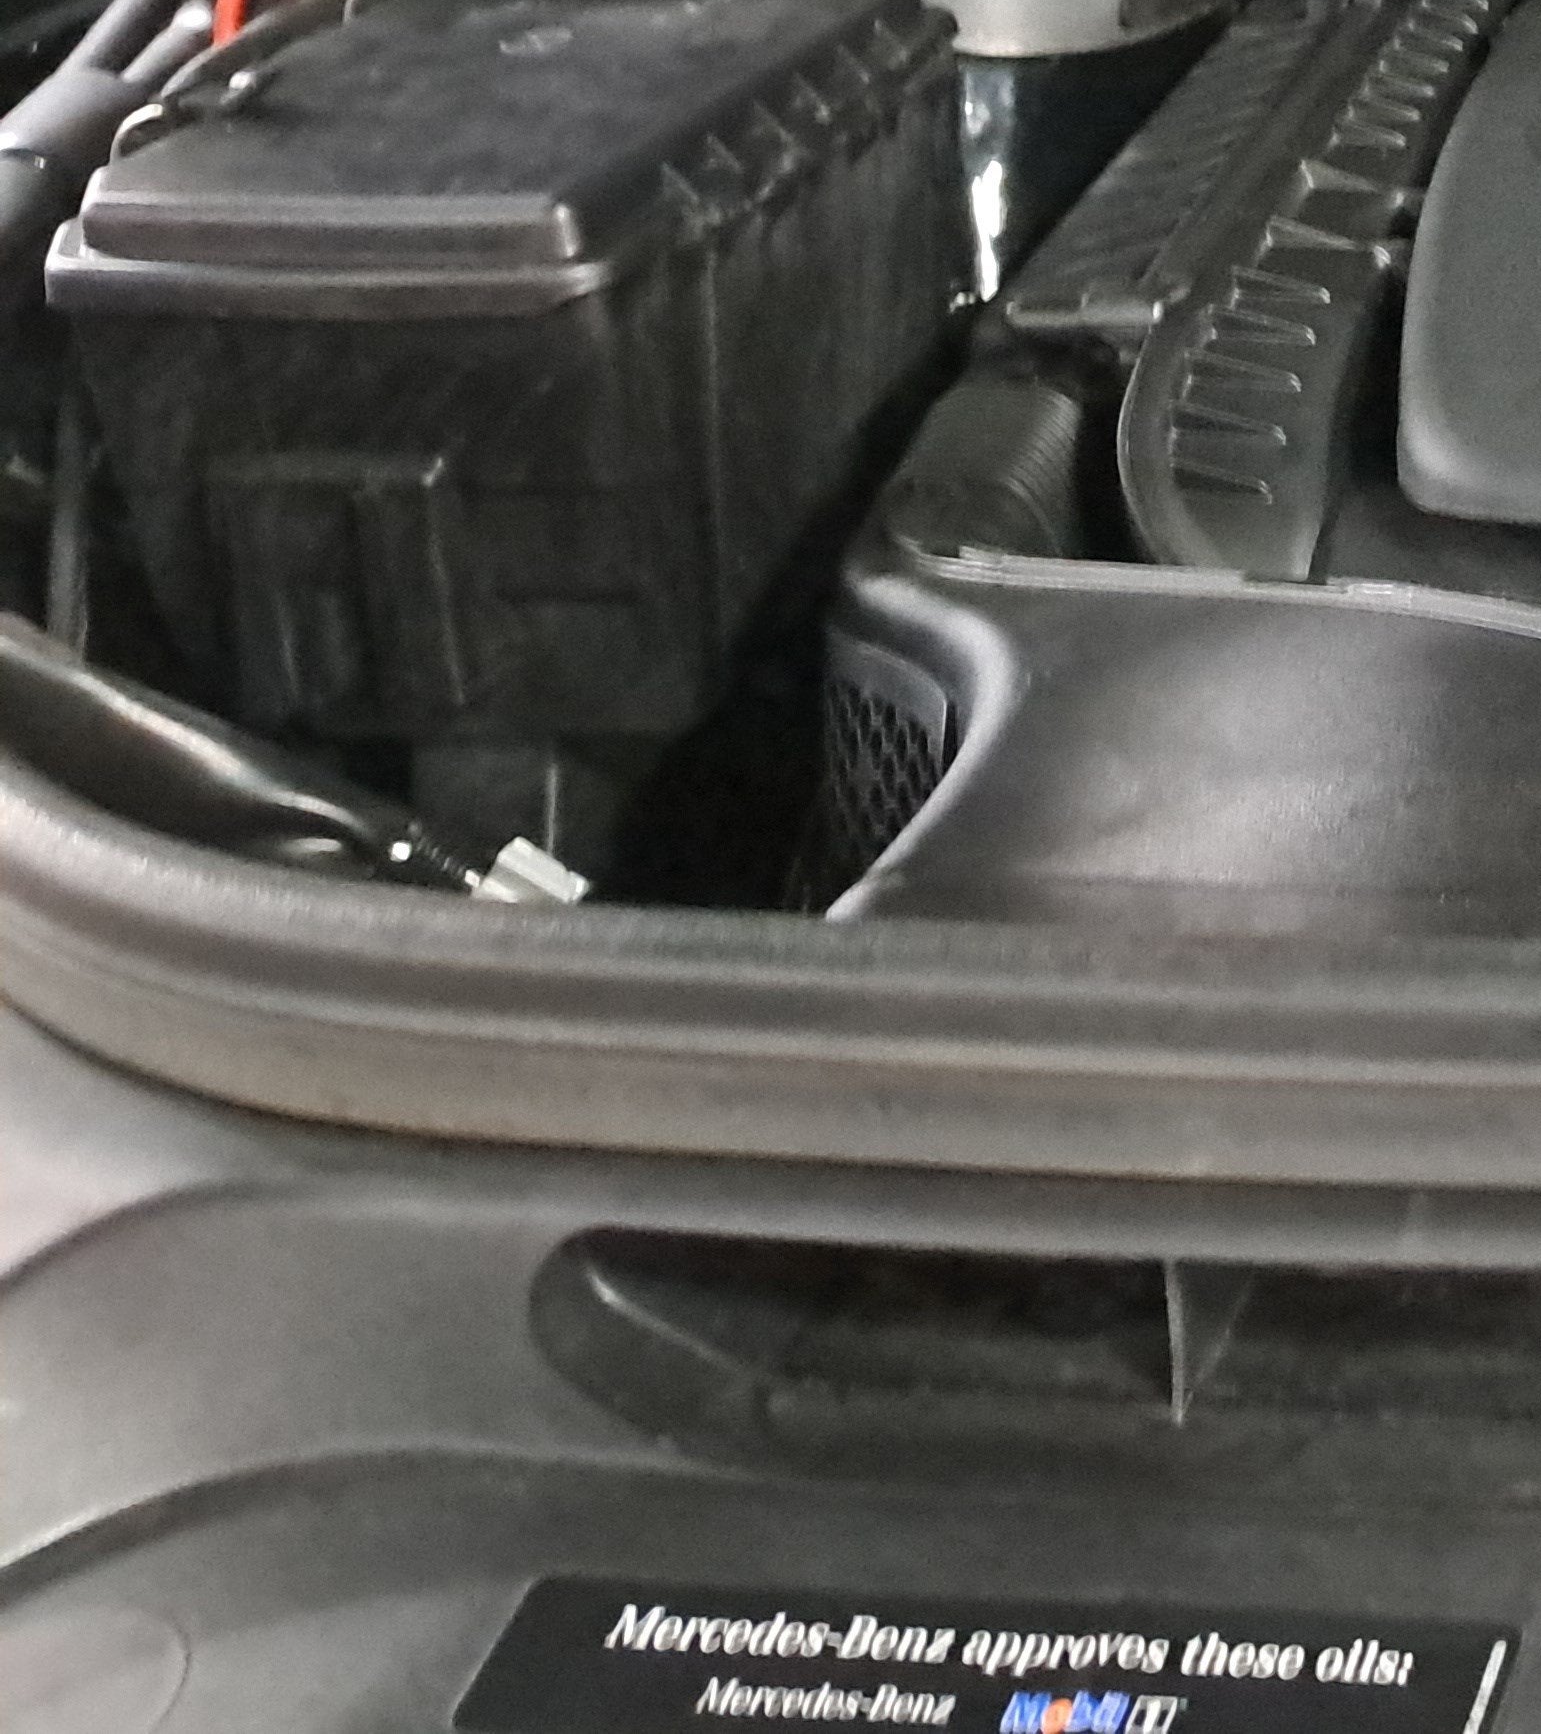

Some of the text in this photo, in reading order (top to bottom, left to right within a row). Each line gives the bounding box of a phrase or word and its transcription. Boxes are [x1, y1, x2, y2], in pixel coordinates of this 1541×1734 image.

[604, 1603, 955, 1662] Mercedes-Benz
[962, 1630, 1169, 1676] approves
[1180, 1631, 1305, 1681] these
[695, 1676, 956, 1726] Mercedes-Benz
[999, 1689, 1131, 1733] Mobil
